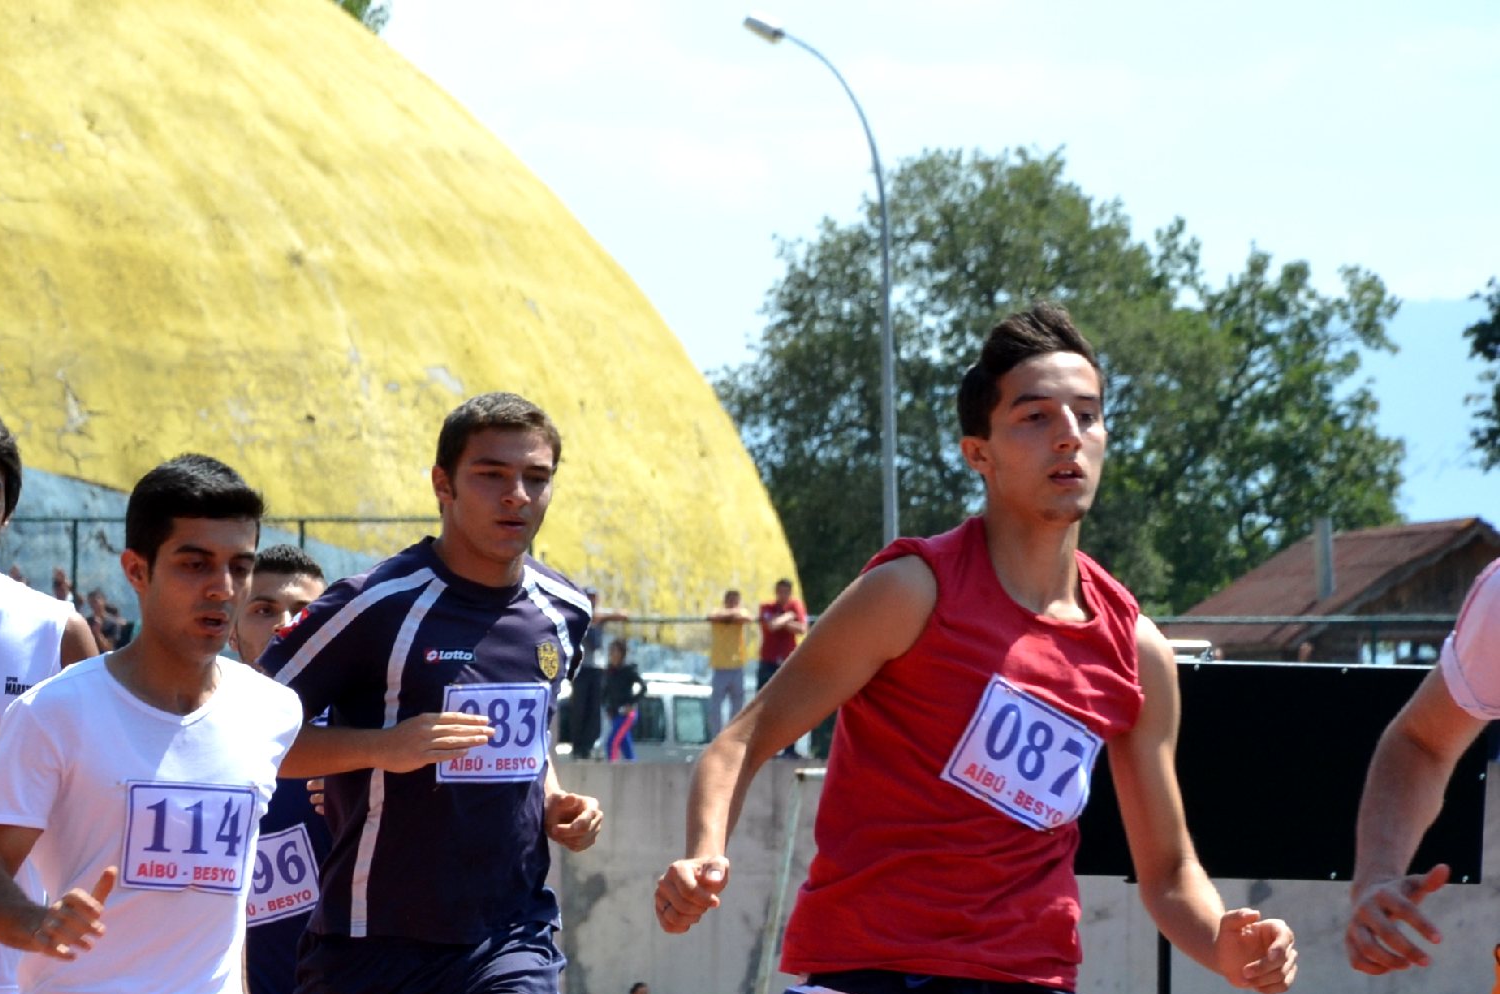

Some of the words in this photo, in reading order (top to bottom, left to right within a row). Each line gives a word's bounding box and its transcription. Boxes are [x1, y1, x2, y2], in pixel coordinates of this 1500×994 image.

[449, 755, 483, 771] AİBÜ
[495, 757, 537, 771] BESYO
[985, 702, 1085, 798] 087
[963, 763, 1007, 794] AİBÜ
[1012, 788, 1063, 825] BESYO
[143, 796, 243, 857] 114
[137, 860, 178, 879] AİBÜ
[193, 866, 236, 882] BESYO
[252, 840, 307, 895] 96
[267, 889, 312, 912] BESYO
